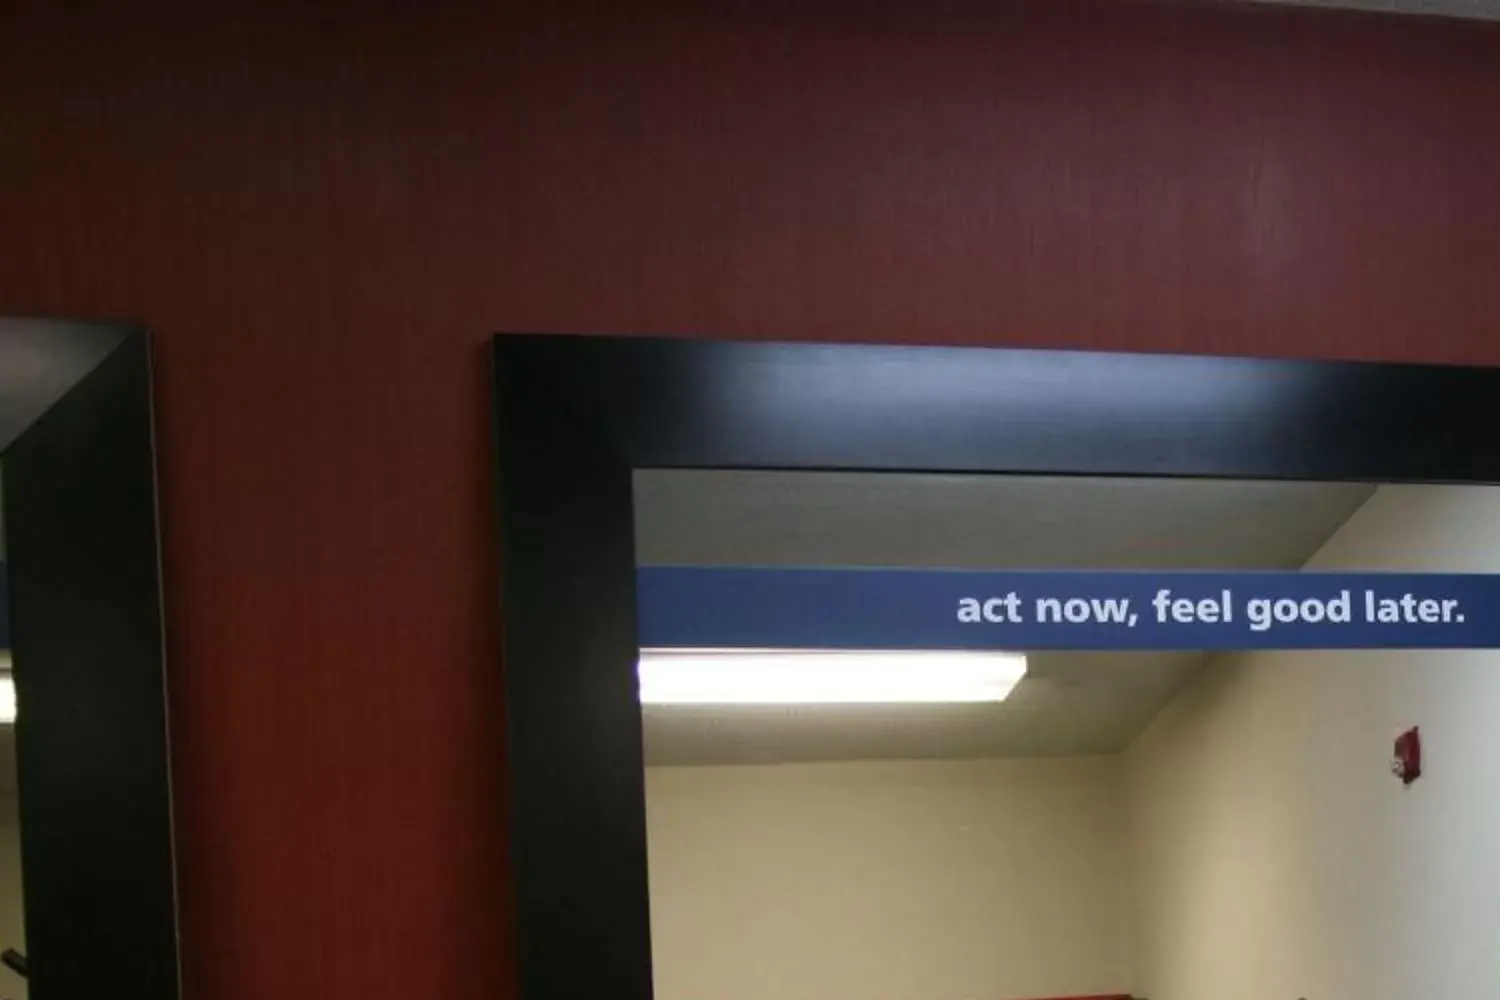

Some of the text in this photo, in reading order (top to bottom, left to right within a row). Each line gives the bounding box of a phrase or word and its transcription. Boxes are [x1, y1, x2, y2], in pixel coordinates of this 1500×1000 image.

[957, 589, 1464, 631] act now, feel good later.
